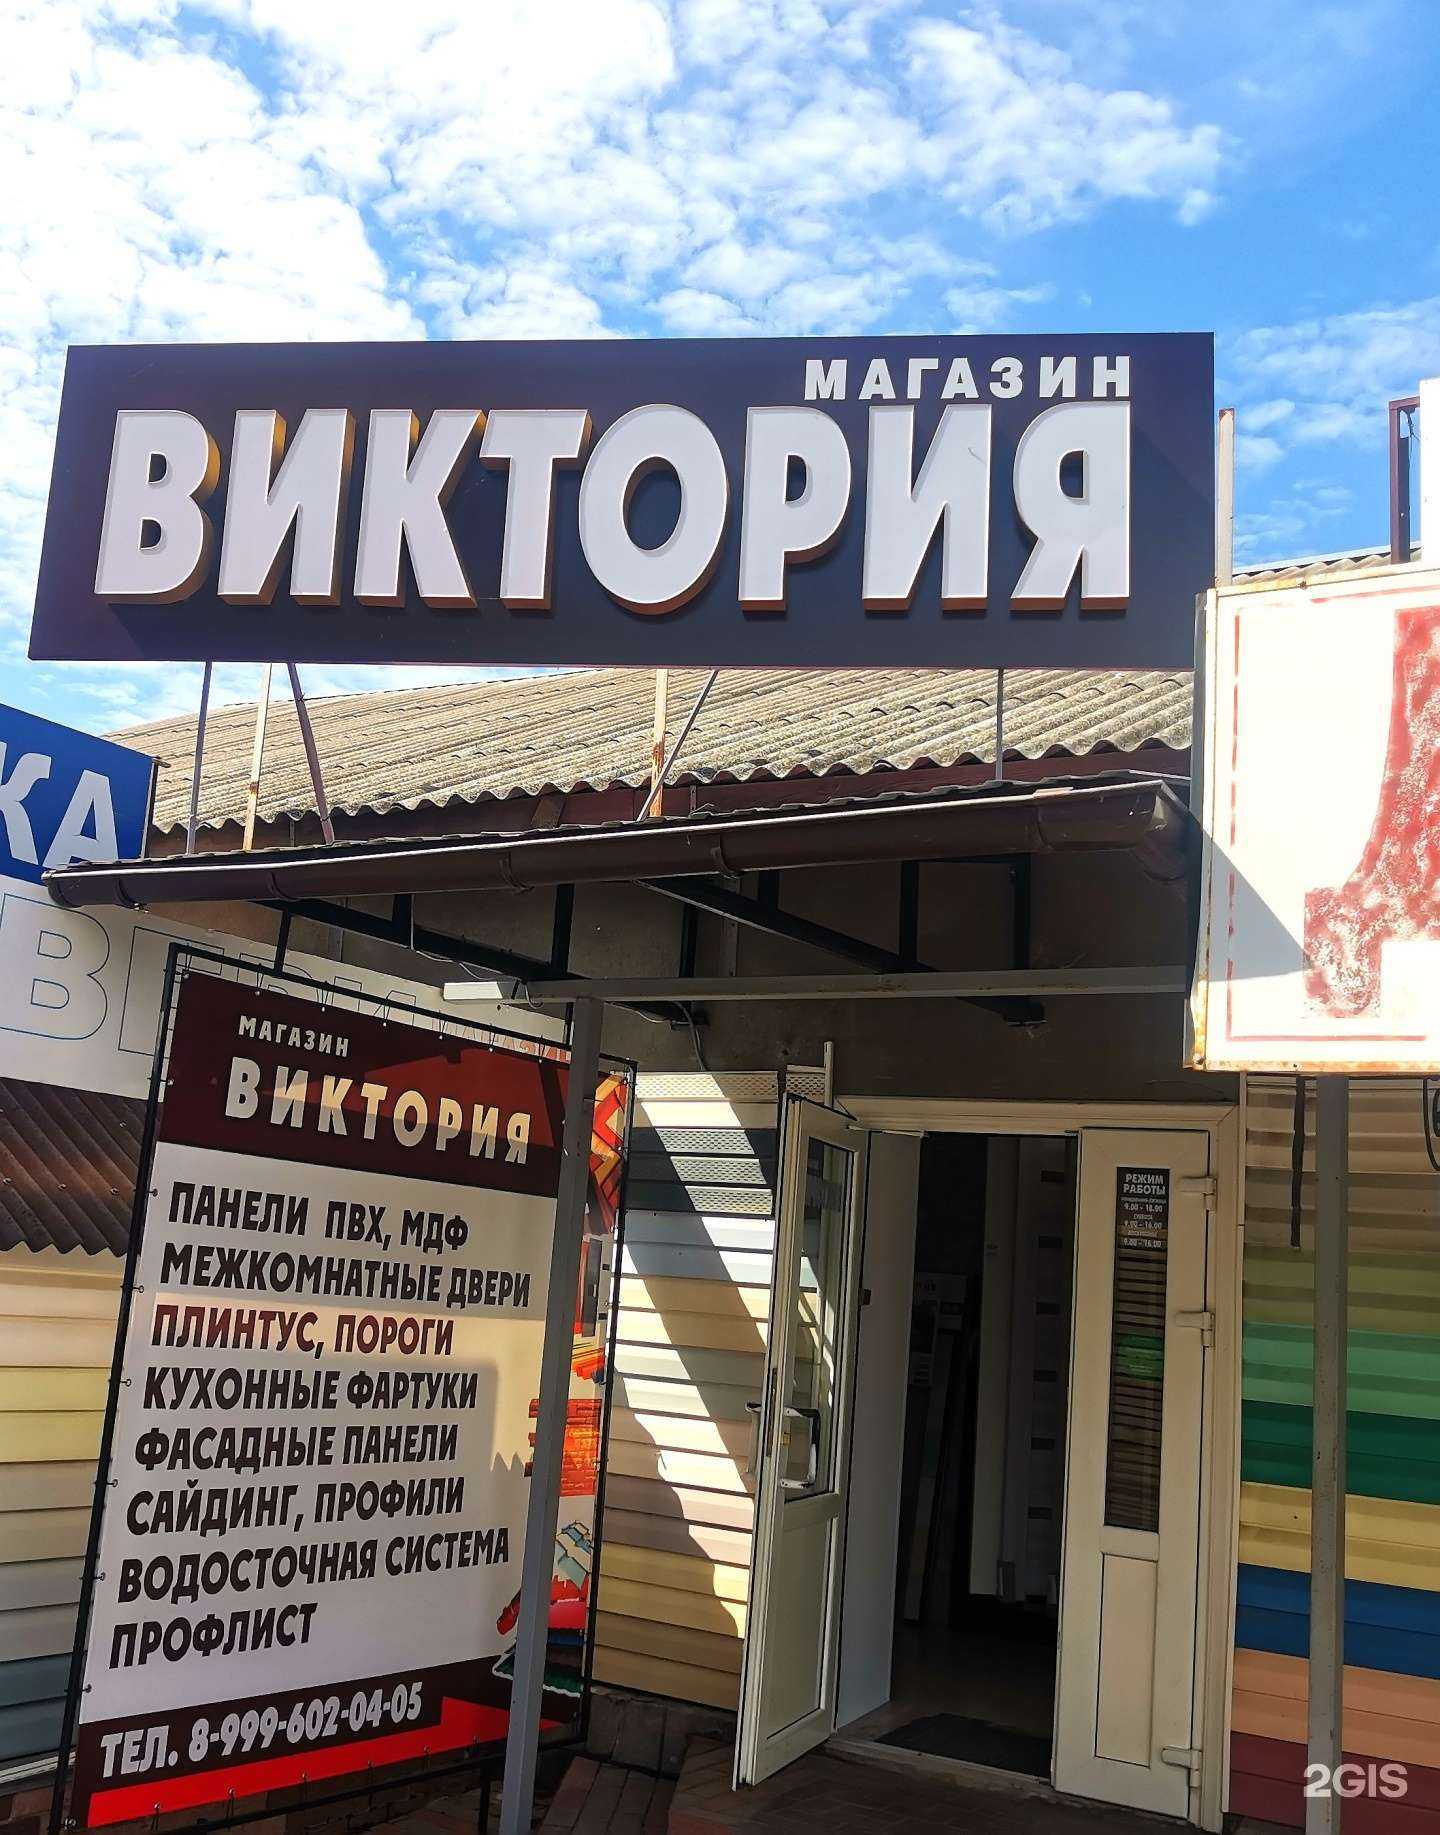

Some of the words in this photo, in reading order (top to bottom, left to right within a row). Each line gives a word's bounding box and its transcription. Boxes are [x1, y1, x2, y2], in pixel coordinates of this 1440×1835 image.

[803, 355, 1132, 400] МАГАЗИН
[93, 400, 1132, 612] ВИКТОРИЯ
[0, 740, 119, 870] КА
[238, 1014, 350, 1058] МАГАЗИН
[225, 1056, 532, 1166] ВИКТОРИЯ
[1123, 1184, 1166, 1195] РАБОТЫ
[1125, 1173, 1164, 1185] РЕЖИМ
[168, 1181, 310, 1236] ПАНЕЛИ
[324, 1200, 391, 1251] ПВХ,
[400, 1209, 469, 1252] МДФ
[160, 1243, 441, 1302] МЕЖКОМНАТНЫЕ
[446, 1267, 532, 1309] ДВЕРИ
[151, 1304, 325, 1359] ПЛИНТУС,
[334, 1314, 455, 1356] ПОРОГИ
[142, 1366, 341, 1410] КУХОННЫЕ
[346, 1371, 479, 1409] ФАРТУКИ
[135, 1426, 334, 1474] ФАСАДНЫЕ
[342, 1424, 460, 1465] ПАНЕЛИ
[126, 1479, 304, 1537] САЙДИНГ,
[314, 1476, 466, 1524] ПРОФИЛИ
[118, 1538, 379, 1605] ВОДОСТОЧНАЯ
[385, 1527, 510, 1576] СИСТЕМА
[109, 1602, 318, 1670] ПРОФЛИСТ
[100, 1725, 179, 1779] ТЕЛ.
[188, 1681, 424, 1763] 8-999-602-04-05
